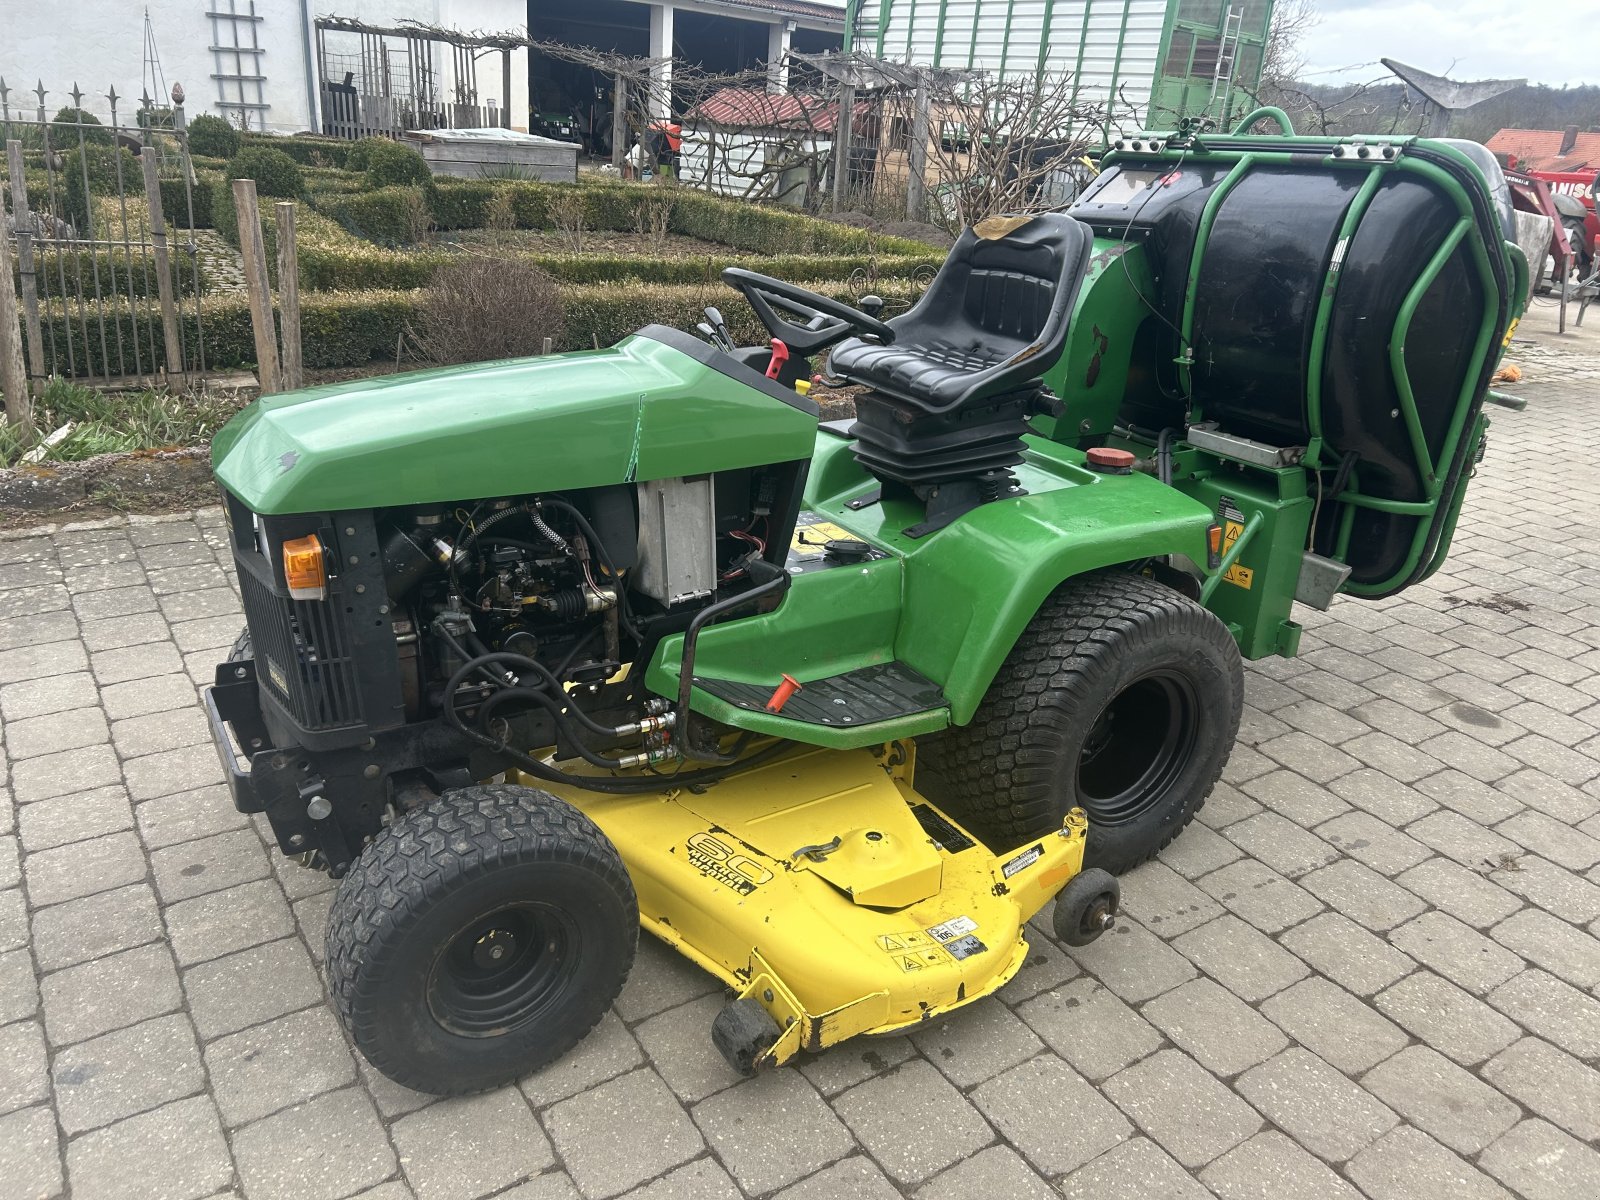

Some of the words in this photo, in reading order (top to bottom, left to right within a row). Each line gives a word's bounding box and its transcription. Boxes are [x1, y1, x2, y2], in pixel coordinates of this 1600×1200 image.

[688, 849, 745, 885] MULCHER
[689, 858, 750, 895] MPATIBLE
[937, 930, 954, 941] 105
